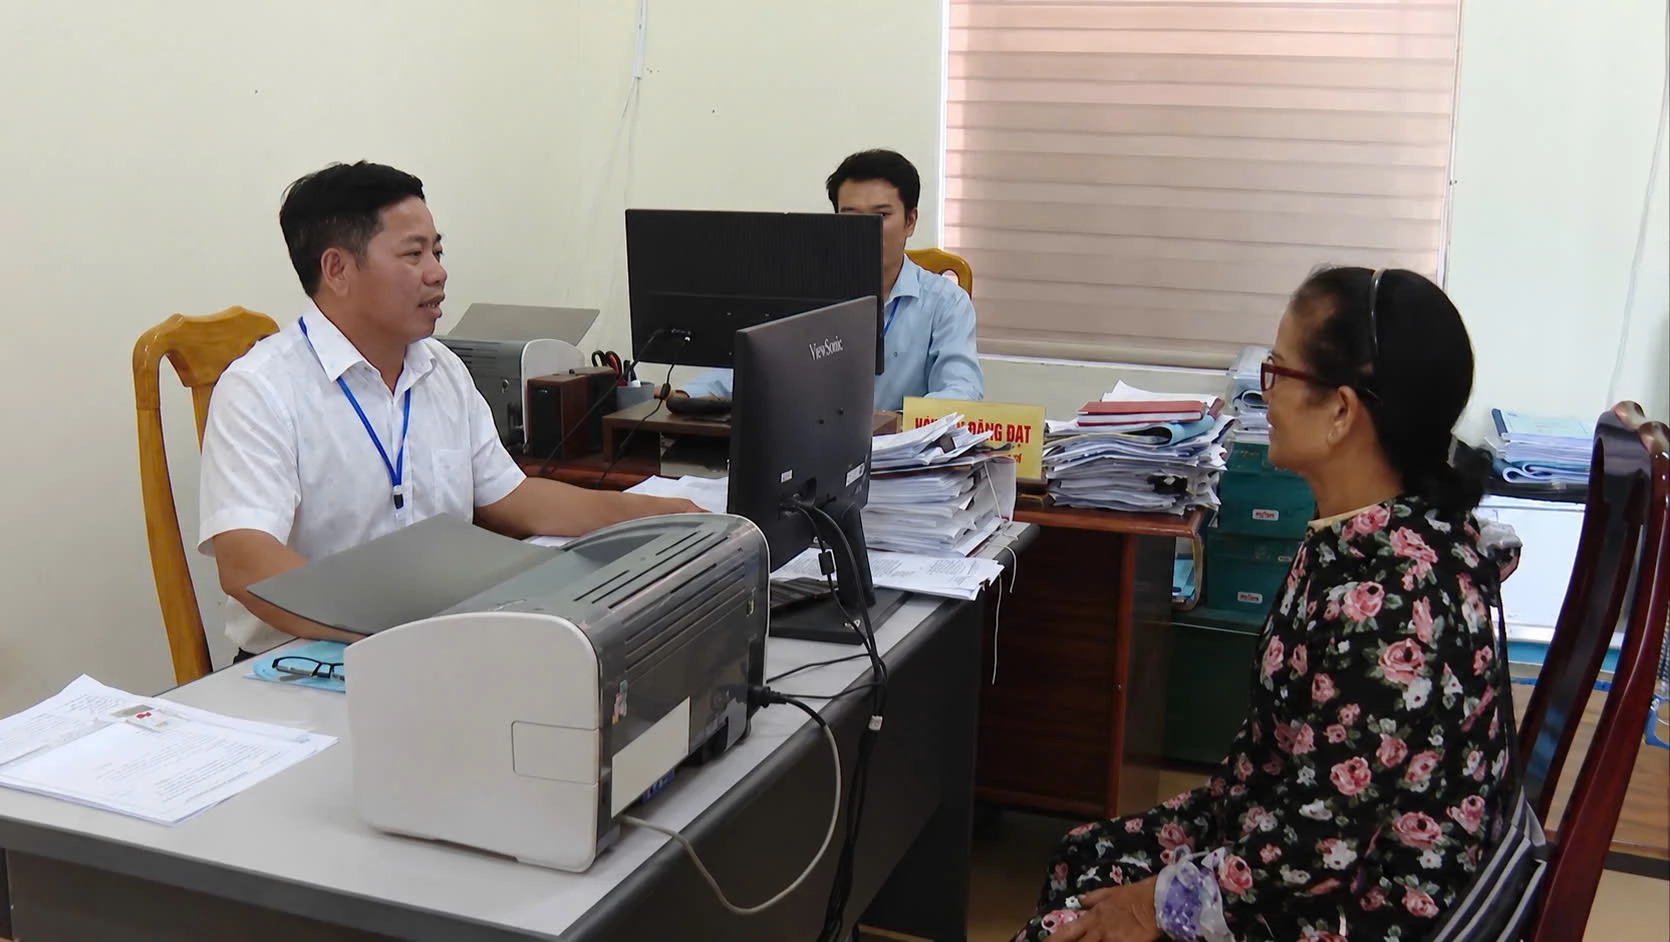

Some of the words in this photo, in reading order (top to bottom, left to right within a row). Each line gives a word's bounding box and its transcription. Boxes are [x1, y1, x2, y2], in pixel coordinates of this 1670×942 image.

[809, 335, 843, 360] ViewSonic
[968, 418, 1003, 442] ĐĂNG
[1006, 424, 1031, 447] ĐẠT
